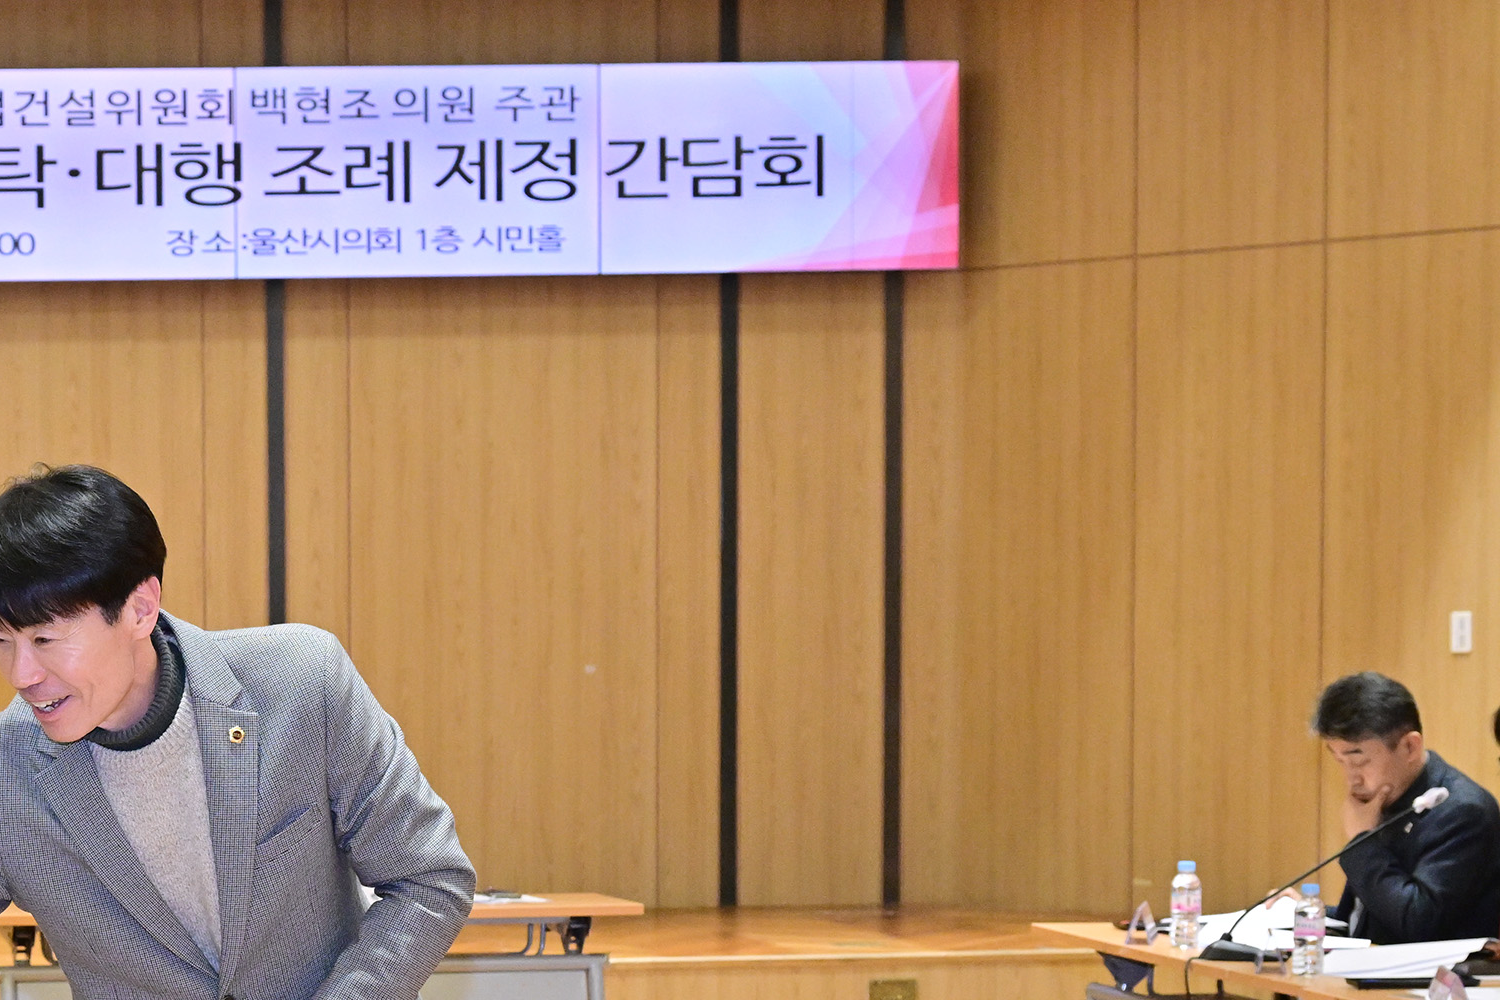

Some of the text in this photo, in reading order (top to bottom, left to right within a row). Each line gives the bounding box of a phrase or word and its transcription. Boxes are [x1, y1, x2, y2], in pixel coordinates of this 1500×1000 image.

[250, 85, 380, 125] 백현조
[391, 85, 475, 124] 의원
[494, 84, 580, 122] 주관
[264, 139, 411, 203] 조례
[434, 137, 578, 202] 제정
[602, 132, 828, 200] 간담회
[415, 225, 466, 255] 1층
[473, 224, 567, 254] 시민홀
